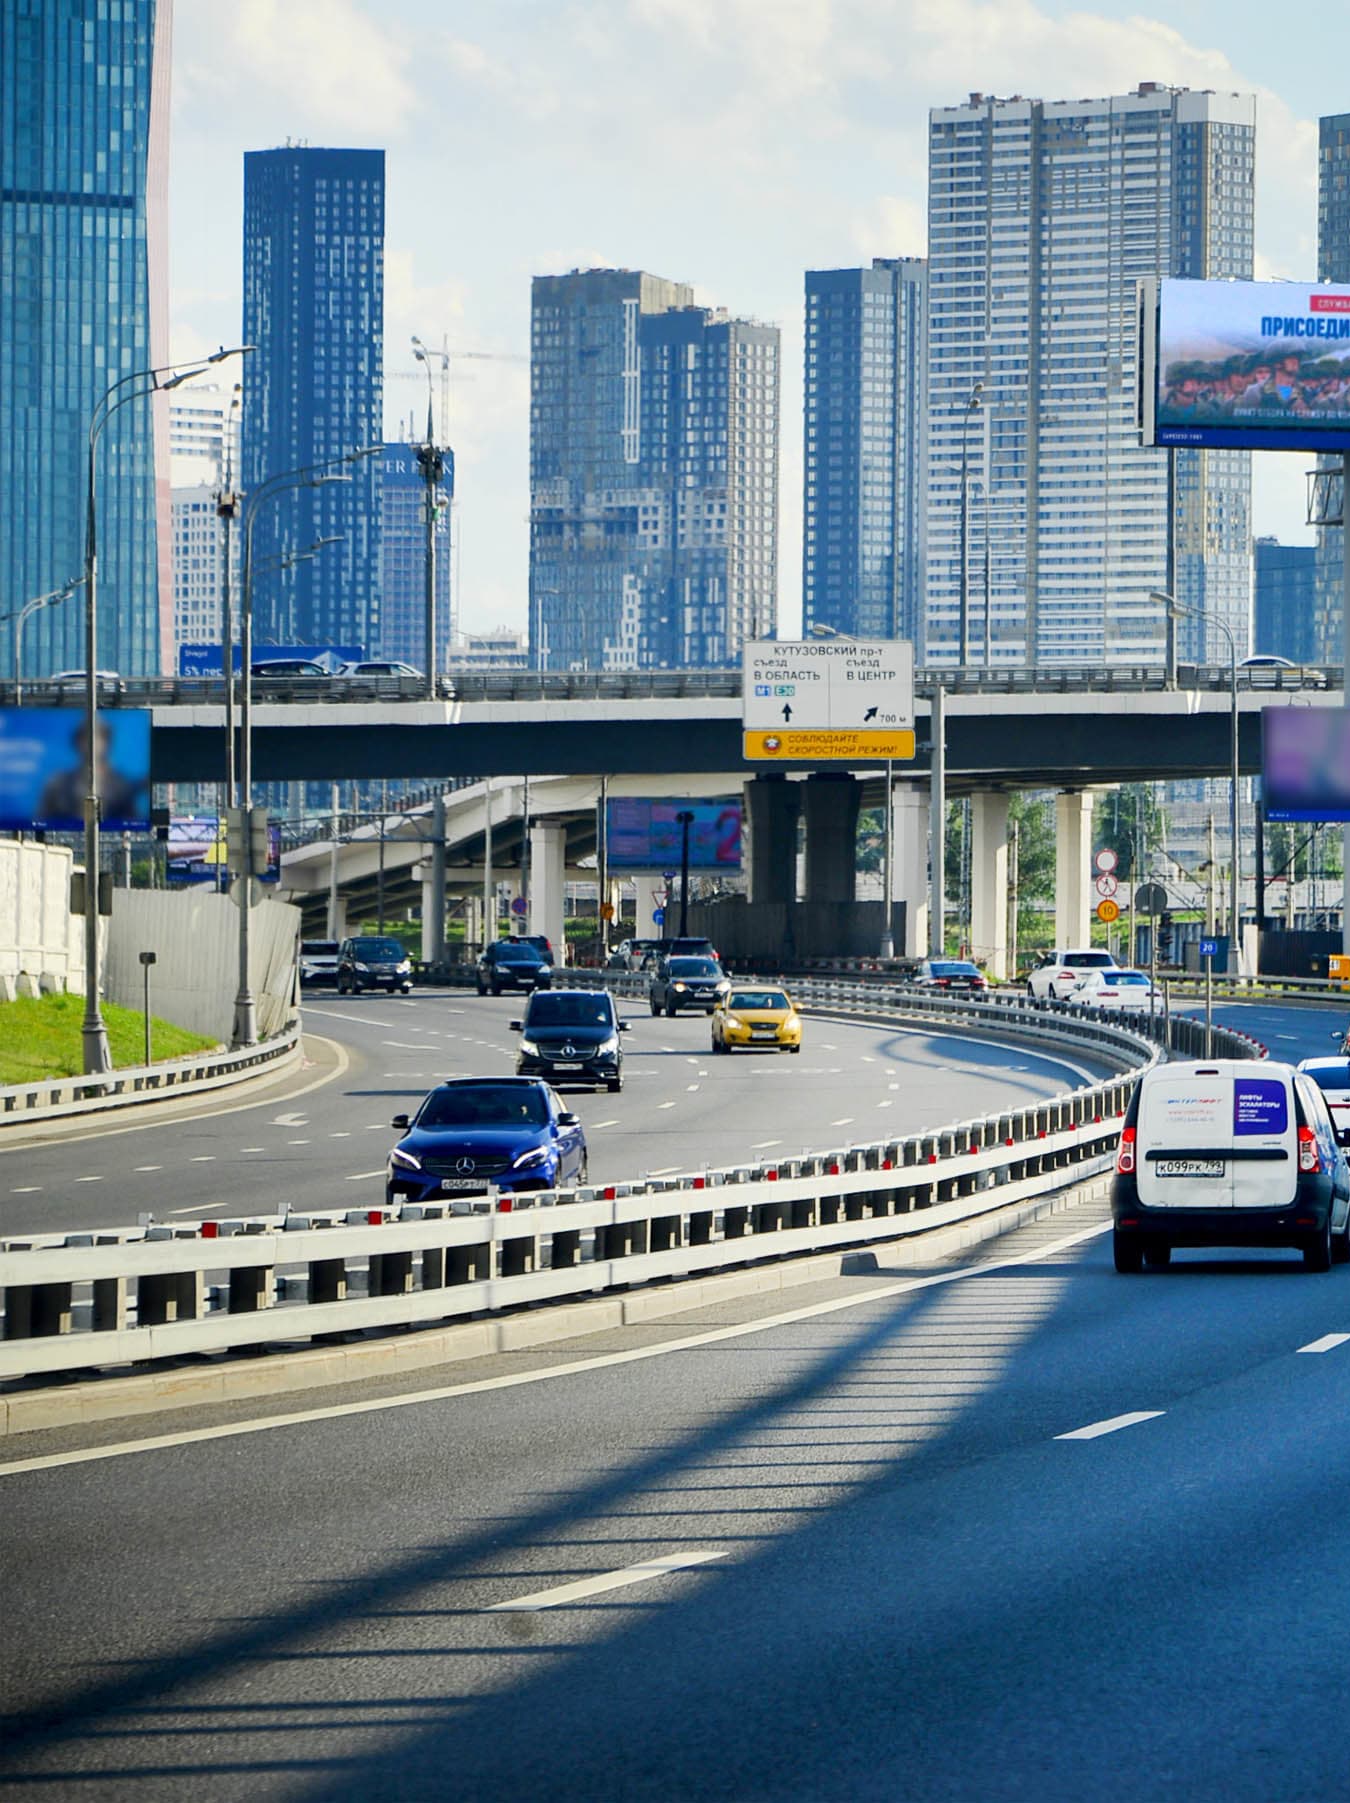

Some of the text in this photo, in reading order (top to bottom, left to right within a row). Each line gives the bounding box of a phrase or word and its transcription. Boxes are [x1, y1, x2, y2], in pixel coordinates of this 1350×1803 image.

[774, 644, 883, 658] КУТУЗОВСКИЙ пр-т
[753, 659, 788, 667] съезд
[846, 659, 880, 667] съезд
[754, 671, 821, 681] В ОБЛАСТЬ
[847, 671, 897, 682] В ЦЕНТР
[880, 714, 896, 723] 700
[788, 735, 859, 744] СОБЛЮДАЙТЕ
[788, 744, 898, 754] СКОРОСТНОЙ РЕЖИМ!
